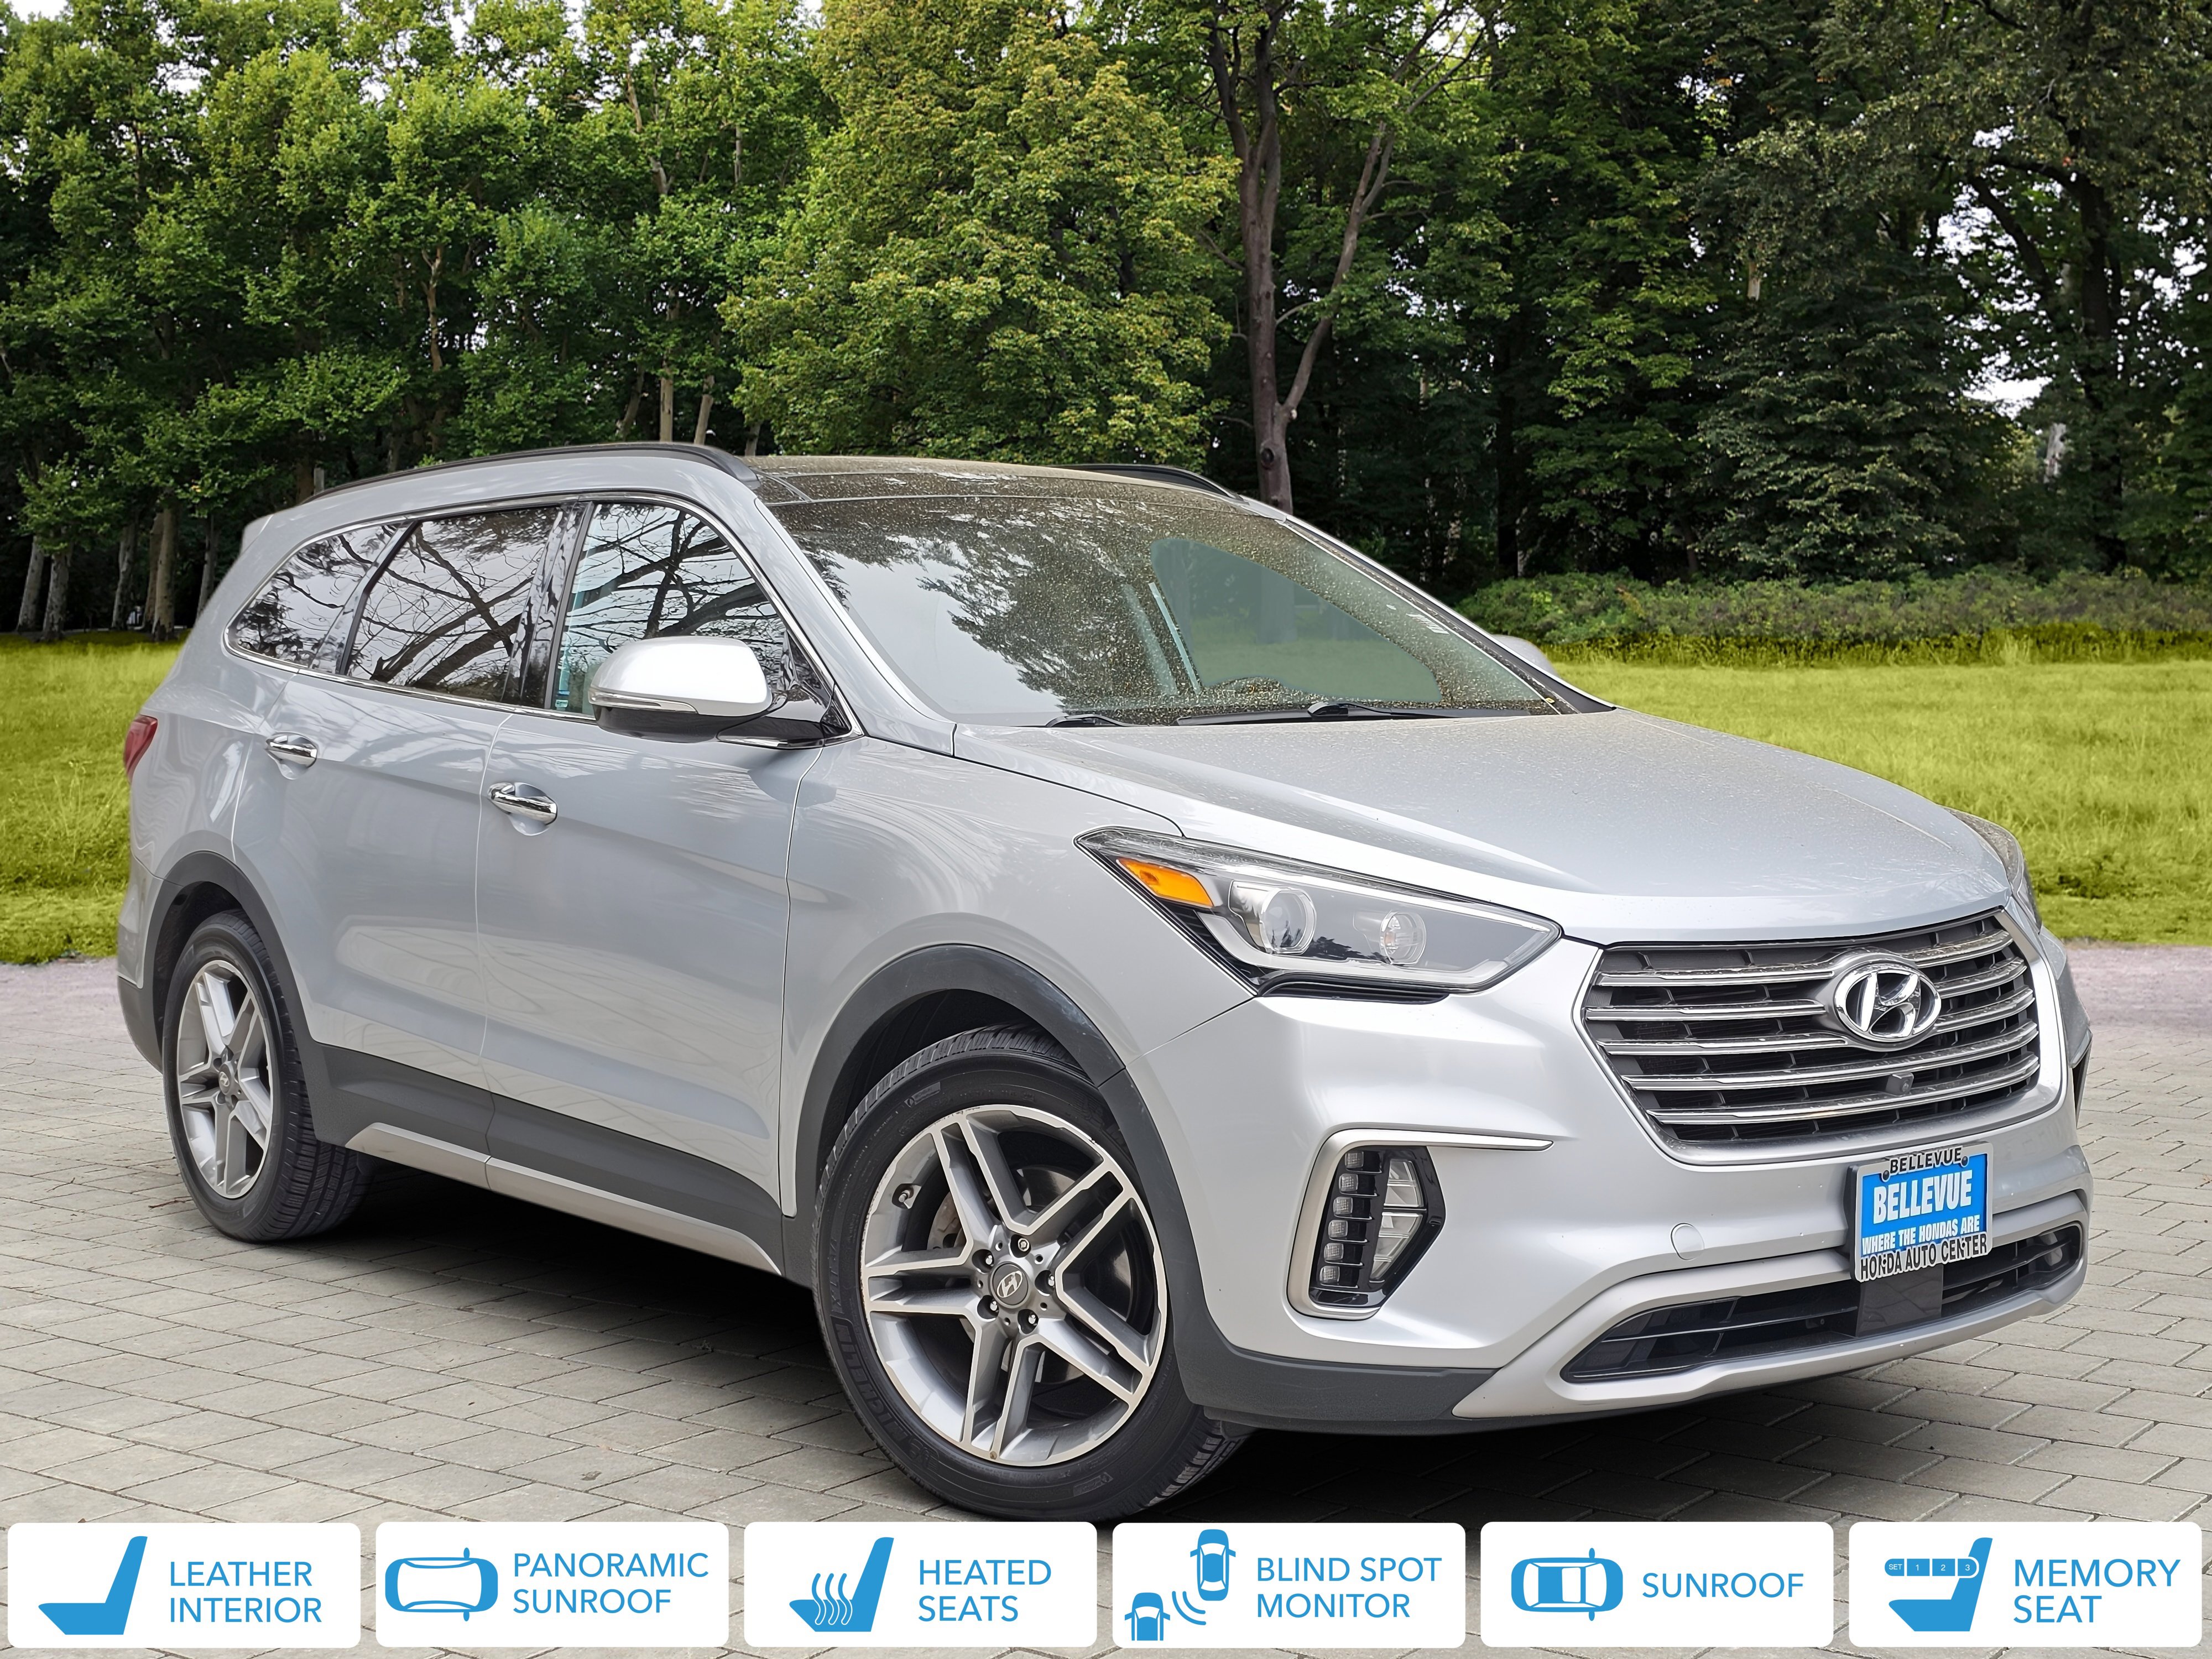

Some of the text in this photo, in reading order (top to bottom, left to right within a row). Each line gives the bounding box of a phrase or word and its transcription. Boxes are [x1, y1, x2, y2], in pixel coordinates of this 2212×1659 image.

[1890, 1147, 1962, 1174] BELLEVUE
[1873, 1170, 1973, 1224] BELLEVUE
[1860, 1233, 1987, 1280] HONDA AUTO CENTER
[1862, 1215, 1980, 1255] WHERE THE HONDAS ARE
[835, 1323, 909, 1442] MICHELIN
